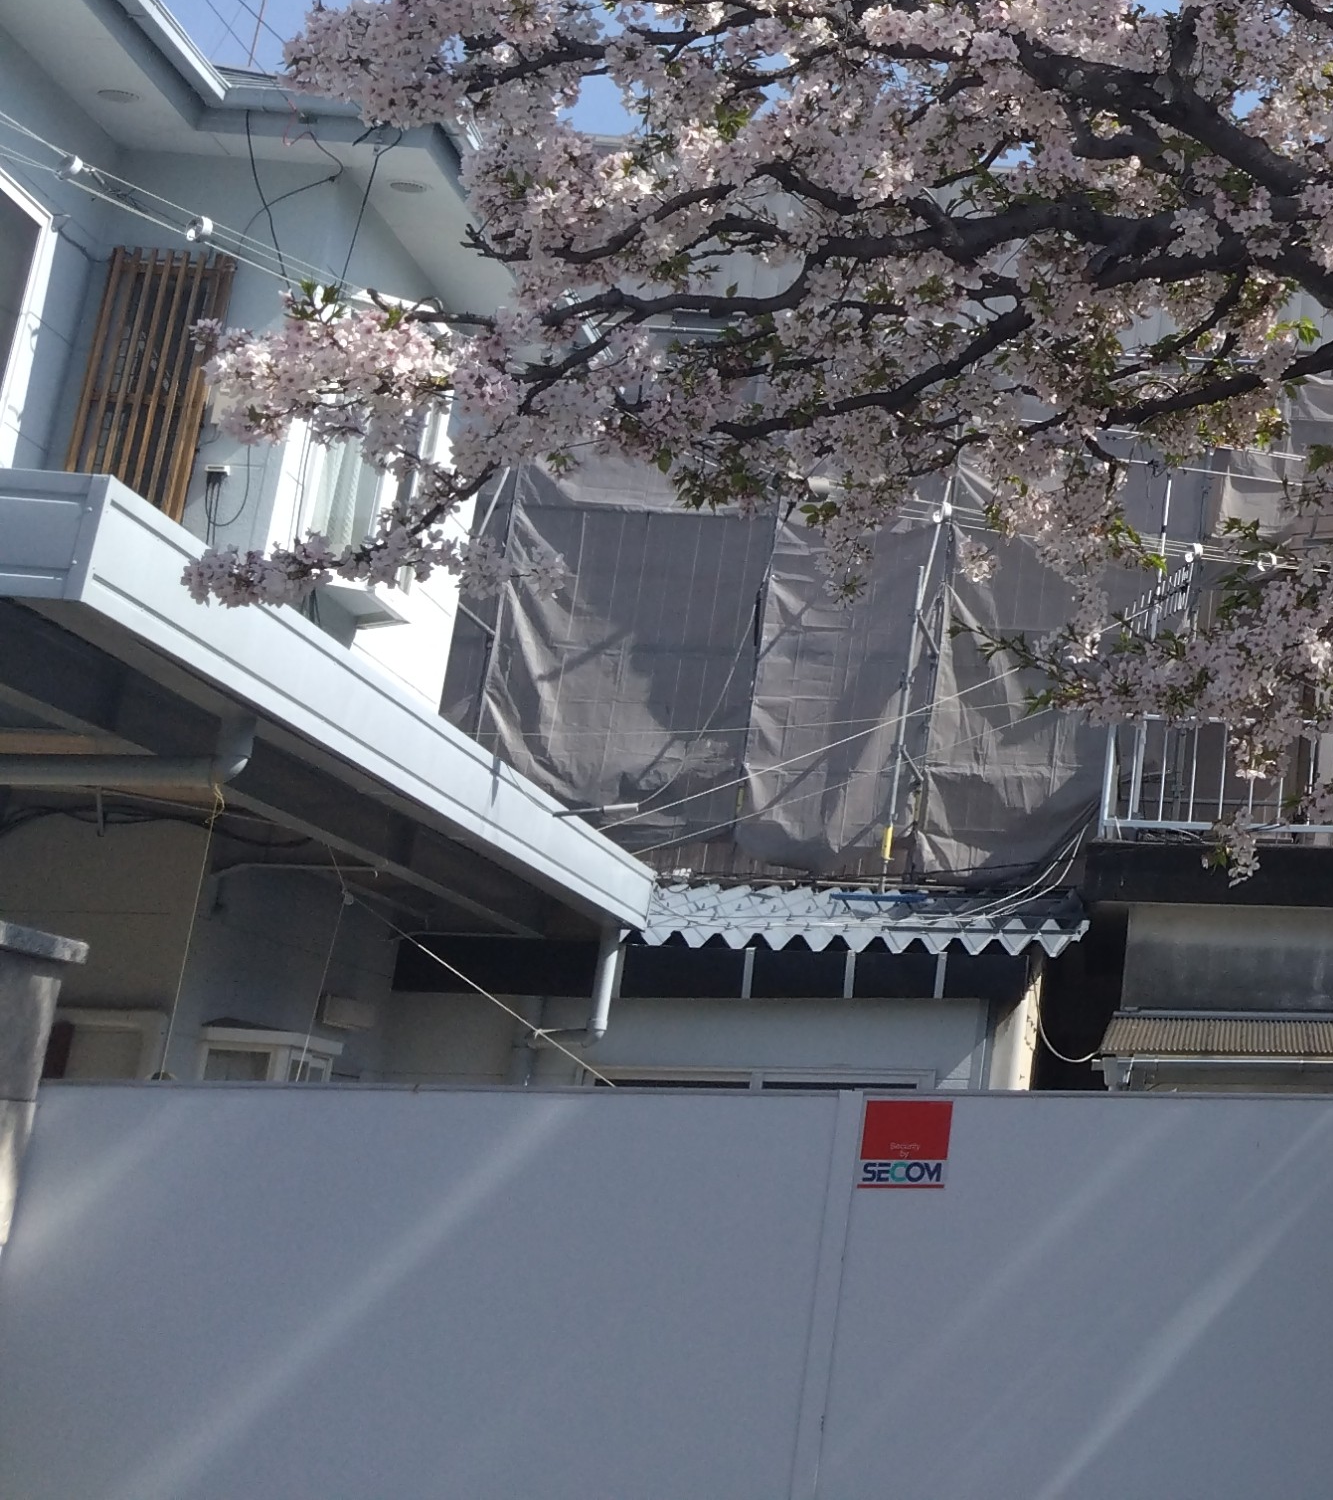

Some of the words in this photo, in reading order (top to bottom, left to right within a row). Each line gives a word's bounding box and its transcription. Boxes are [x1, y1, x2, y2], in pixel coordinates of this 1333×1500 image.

[890, 1142, 921, 1151] Security
[900, 1150, 909, 1159] by
[862, 1162, 942, 1182] SECOM
